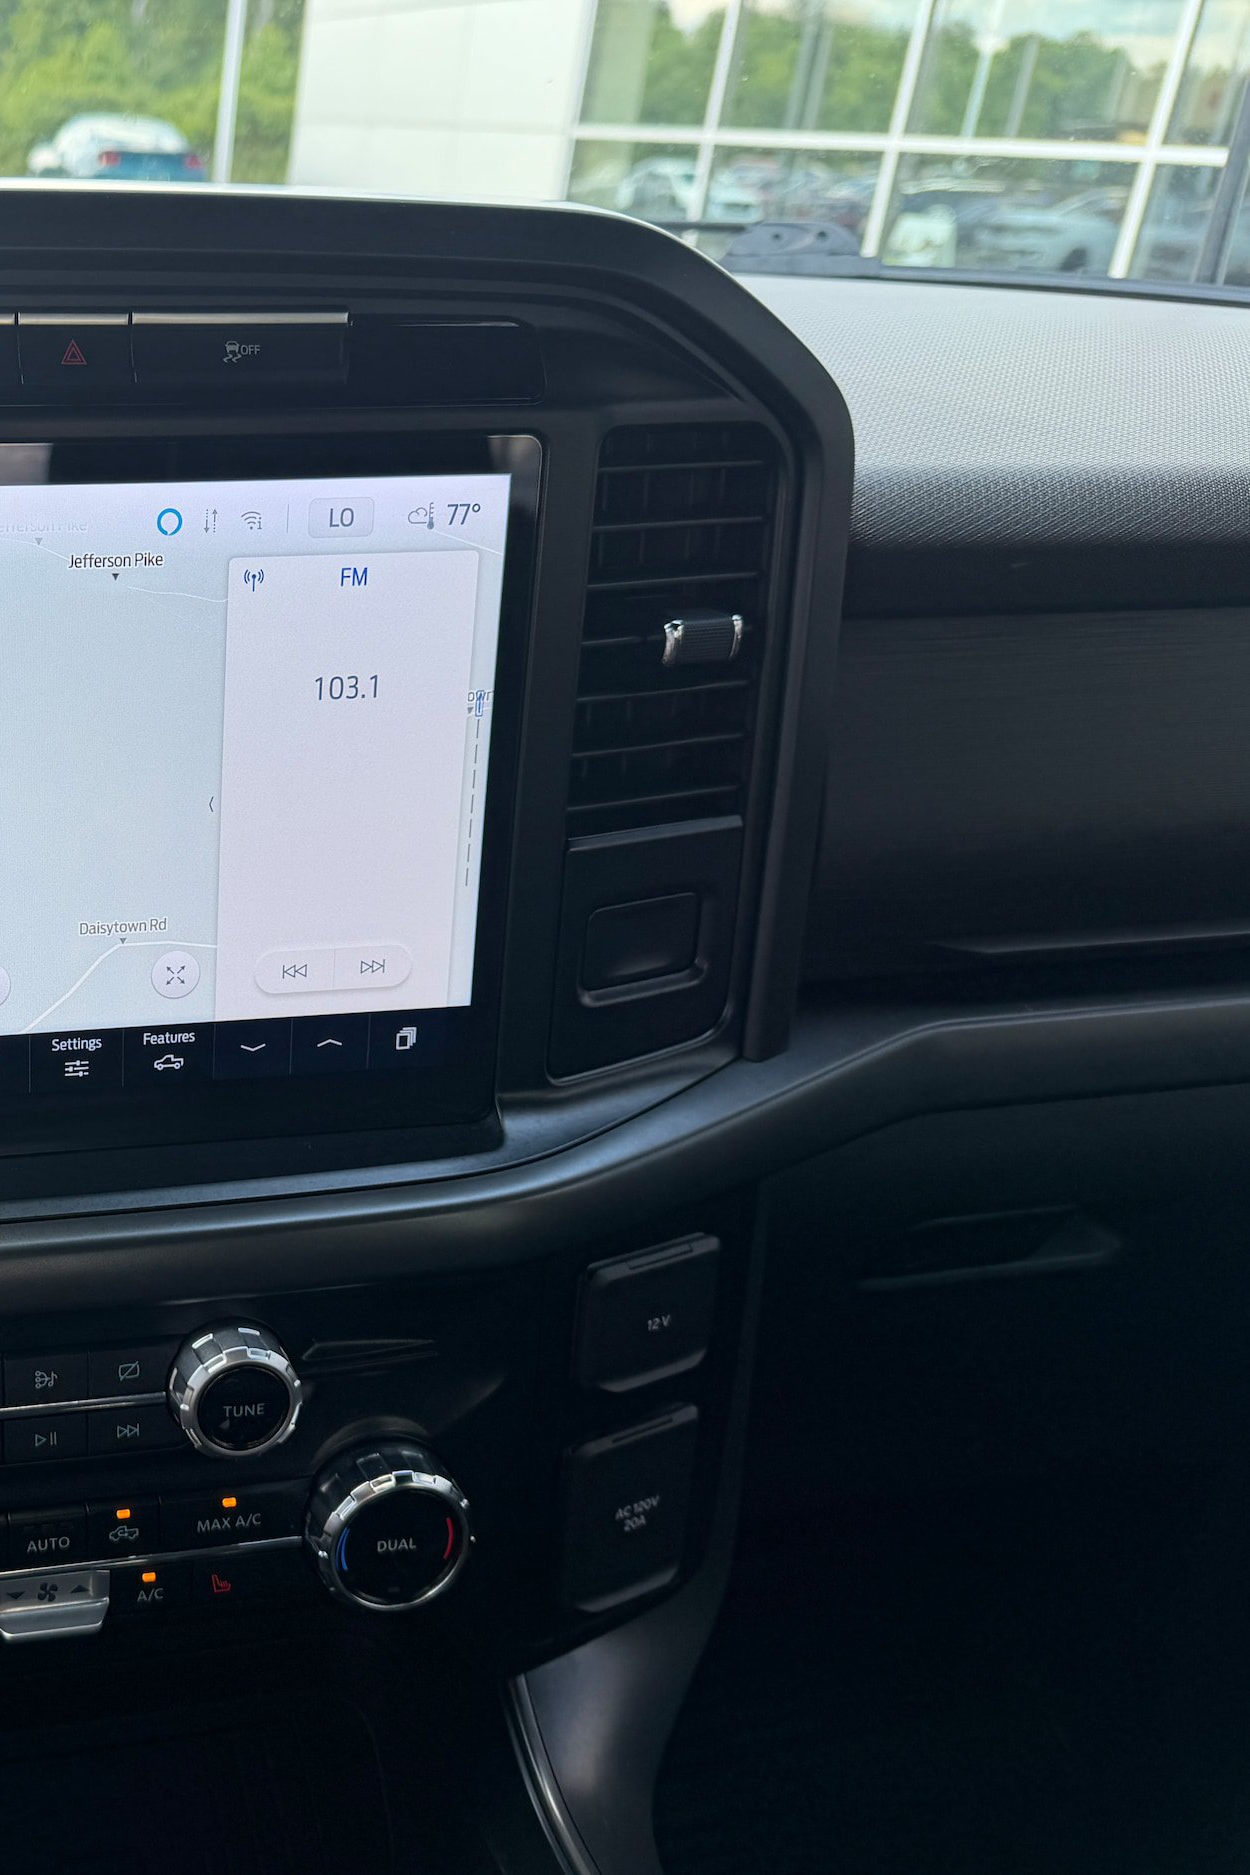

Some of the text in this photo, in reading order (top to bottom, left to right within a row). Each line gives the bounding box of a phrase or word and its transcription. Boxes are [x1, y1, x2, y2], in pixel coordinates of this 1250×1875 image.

[240, 344, 261, 356] OFF
[329, 508, 355, 528] LO
[447, 503, 481, 526] 77°
[68, 552, 163, 569] Jefferson Pike
[340, 568, 368, 586] FM
[313, 674, 380, 700] 103.1
[79, 917, 167, 937] Daisytown Rd
[51, 1036, 102, 1053] Settings
[142, 1031, 196, 1046] Features
[647, 1314, 671, 1331] 12V
[222, 1402, 266, 1418] TUNE
[197, 1511, 262, 1532] MAX A/C
[26, 1536, 71, 1553] AUTO
[376, 1538, 417, 1554] DUAL
[136, 1586, 164, 1602] A/C
